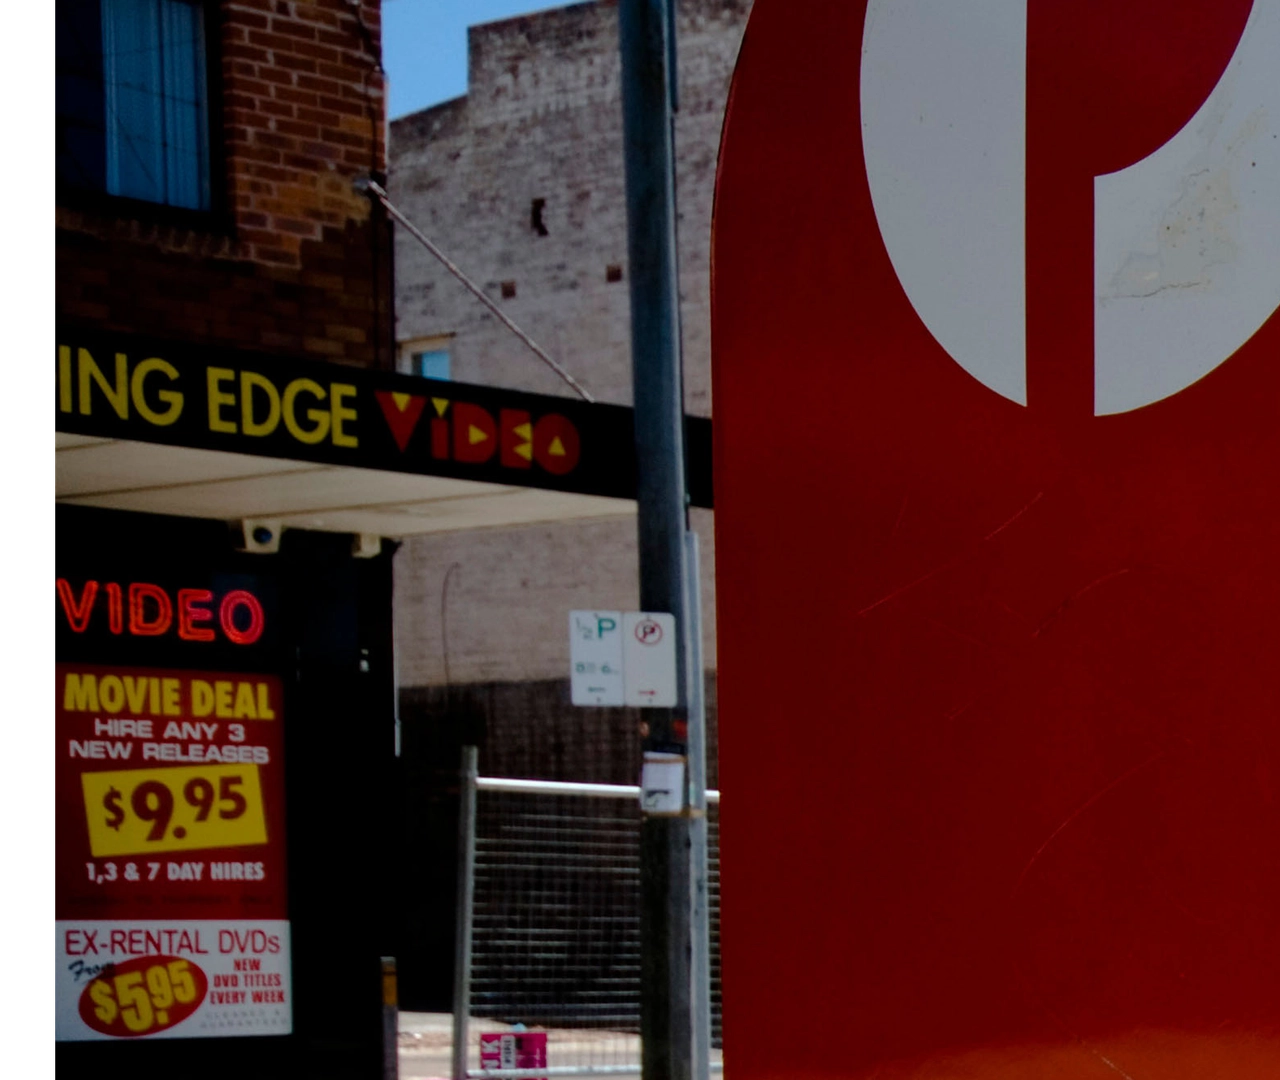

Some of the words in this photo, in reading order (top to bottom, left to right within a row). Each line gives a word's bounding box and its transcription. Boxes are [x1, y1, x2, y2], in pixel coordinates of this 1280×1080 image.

[206, 366, 359, 448] EDGE
[56, 578, 264, 644] VIDEO
[63, 673, 181, 716] MOVIE
[192, 679, 274, 720] DEAL
[94, 718, 153, 740] HIRE
[164, 721, 218, 742] ANY
[229, 724, 245, 742] 3
[69, 739, 135, 760] NEW
[143, 742, 270, 765] RELEASES
[102, 774, 249, 842] $9.95
[124, 863, 140, 881] &
[147, 862, 160, 881] 7
[166, 862, 203, 881] DAY
[210, 862, 265, 881] HIRES
[65, 929, 208, 956] EX-RENTAL
[218, 929, 281, 954] DVDs
[233, 958, 261, 971] NEW
[213, 974, 239, 988] DVD
[243, 973, 282, 988] TITLES
[89, 958, 197, 1033] $5.95
[209, 991, 246, 1005] EVERY
[251, 990, 285, 1004] WEEK
